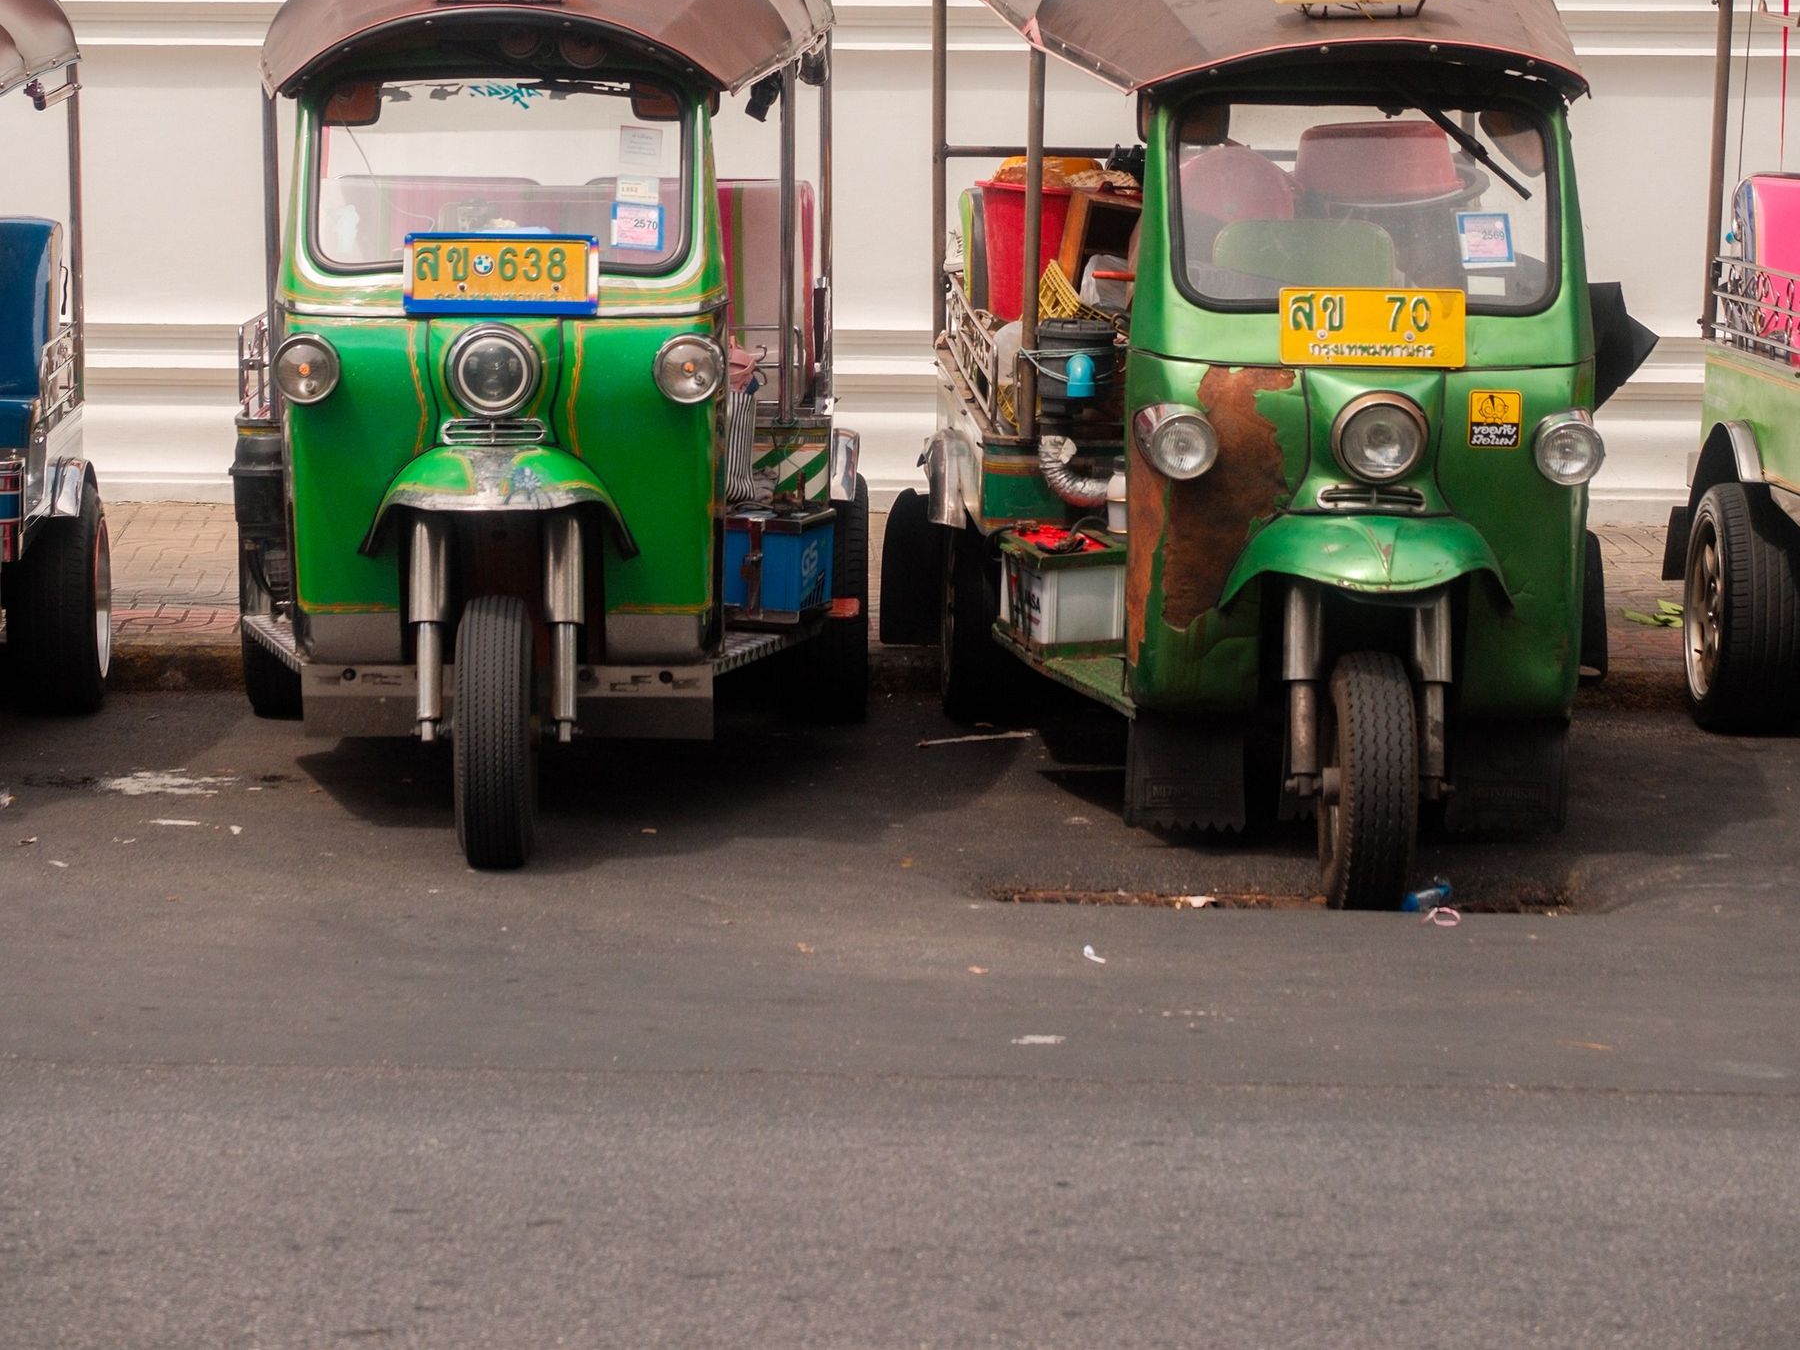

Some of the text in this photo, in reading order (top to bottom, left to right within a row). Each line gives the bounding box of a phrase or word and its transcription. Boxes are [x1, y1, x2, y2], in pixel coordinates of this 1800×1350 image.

[633, 218, 658, 231] 2570
[415, 244, 567, 282] สข 638
[1289, 292, 1431, 333] สข 70
[1309, 342, 1436, 362] กรุงเทพมหานคร
[1472, 424, 1517, 435] ขออภัย
[1471, 434, 1517, 446] มือใหม่
[801, 539, 818, 579] GS
